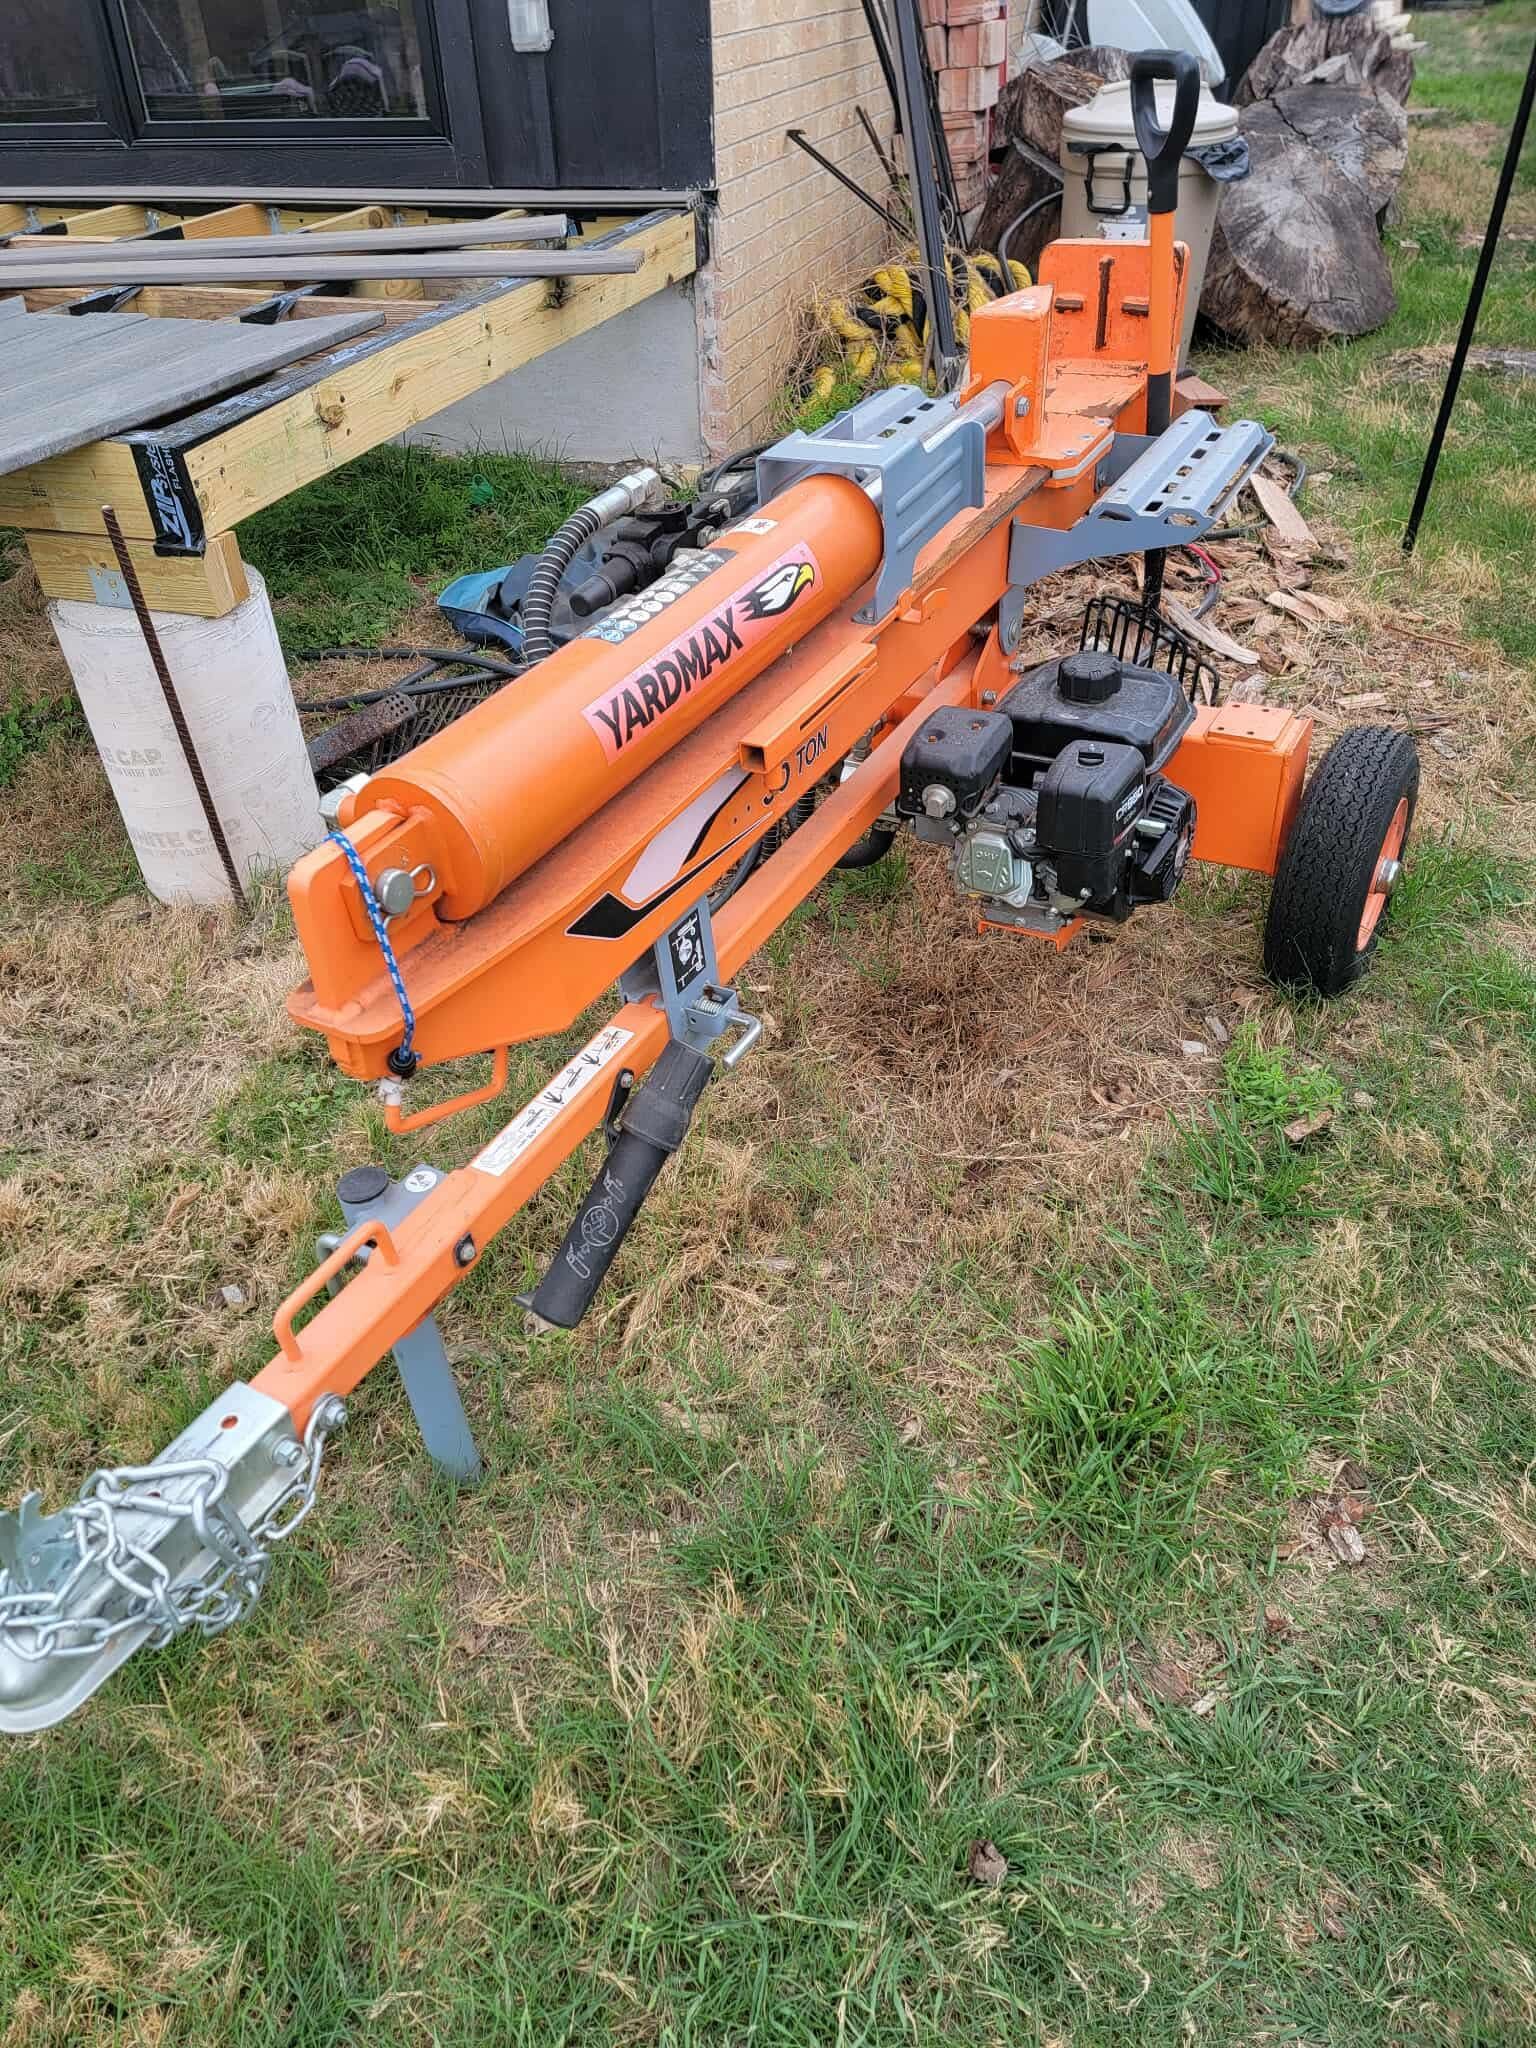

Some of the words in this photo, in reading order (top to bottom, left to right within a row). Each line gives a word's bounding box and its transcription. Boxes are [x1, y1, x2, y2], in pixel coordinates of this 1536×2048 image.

[146, 443, 168, 489] Syste
[161, 440, 182, 490] FLASH
[151, 478, 182, 537] ZIP
[593, 607, 744, 750] YARDMAX
[796, 724, 828, 774] TON
[186, 816, 242, 848] CP
